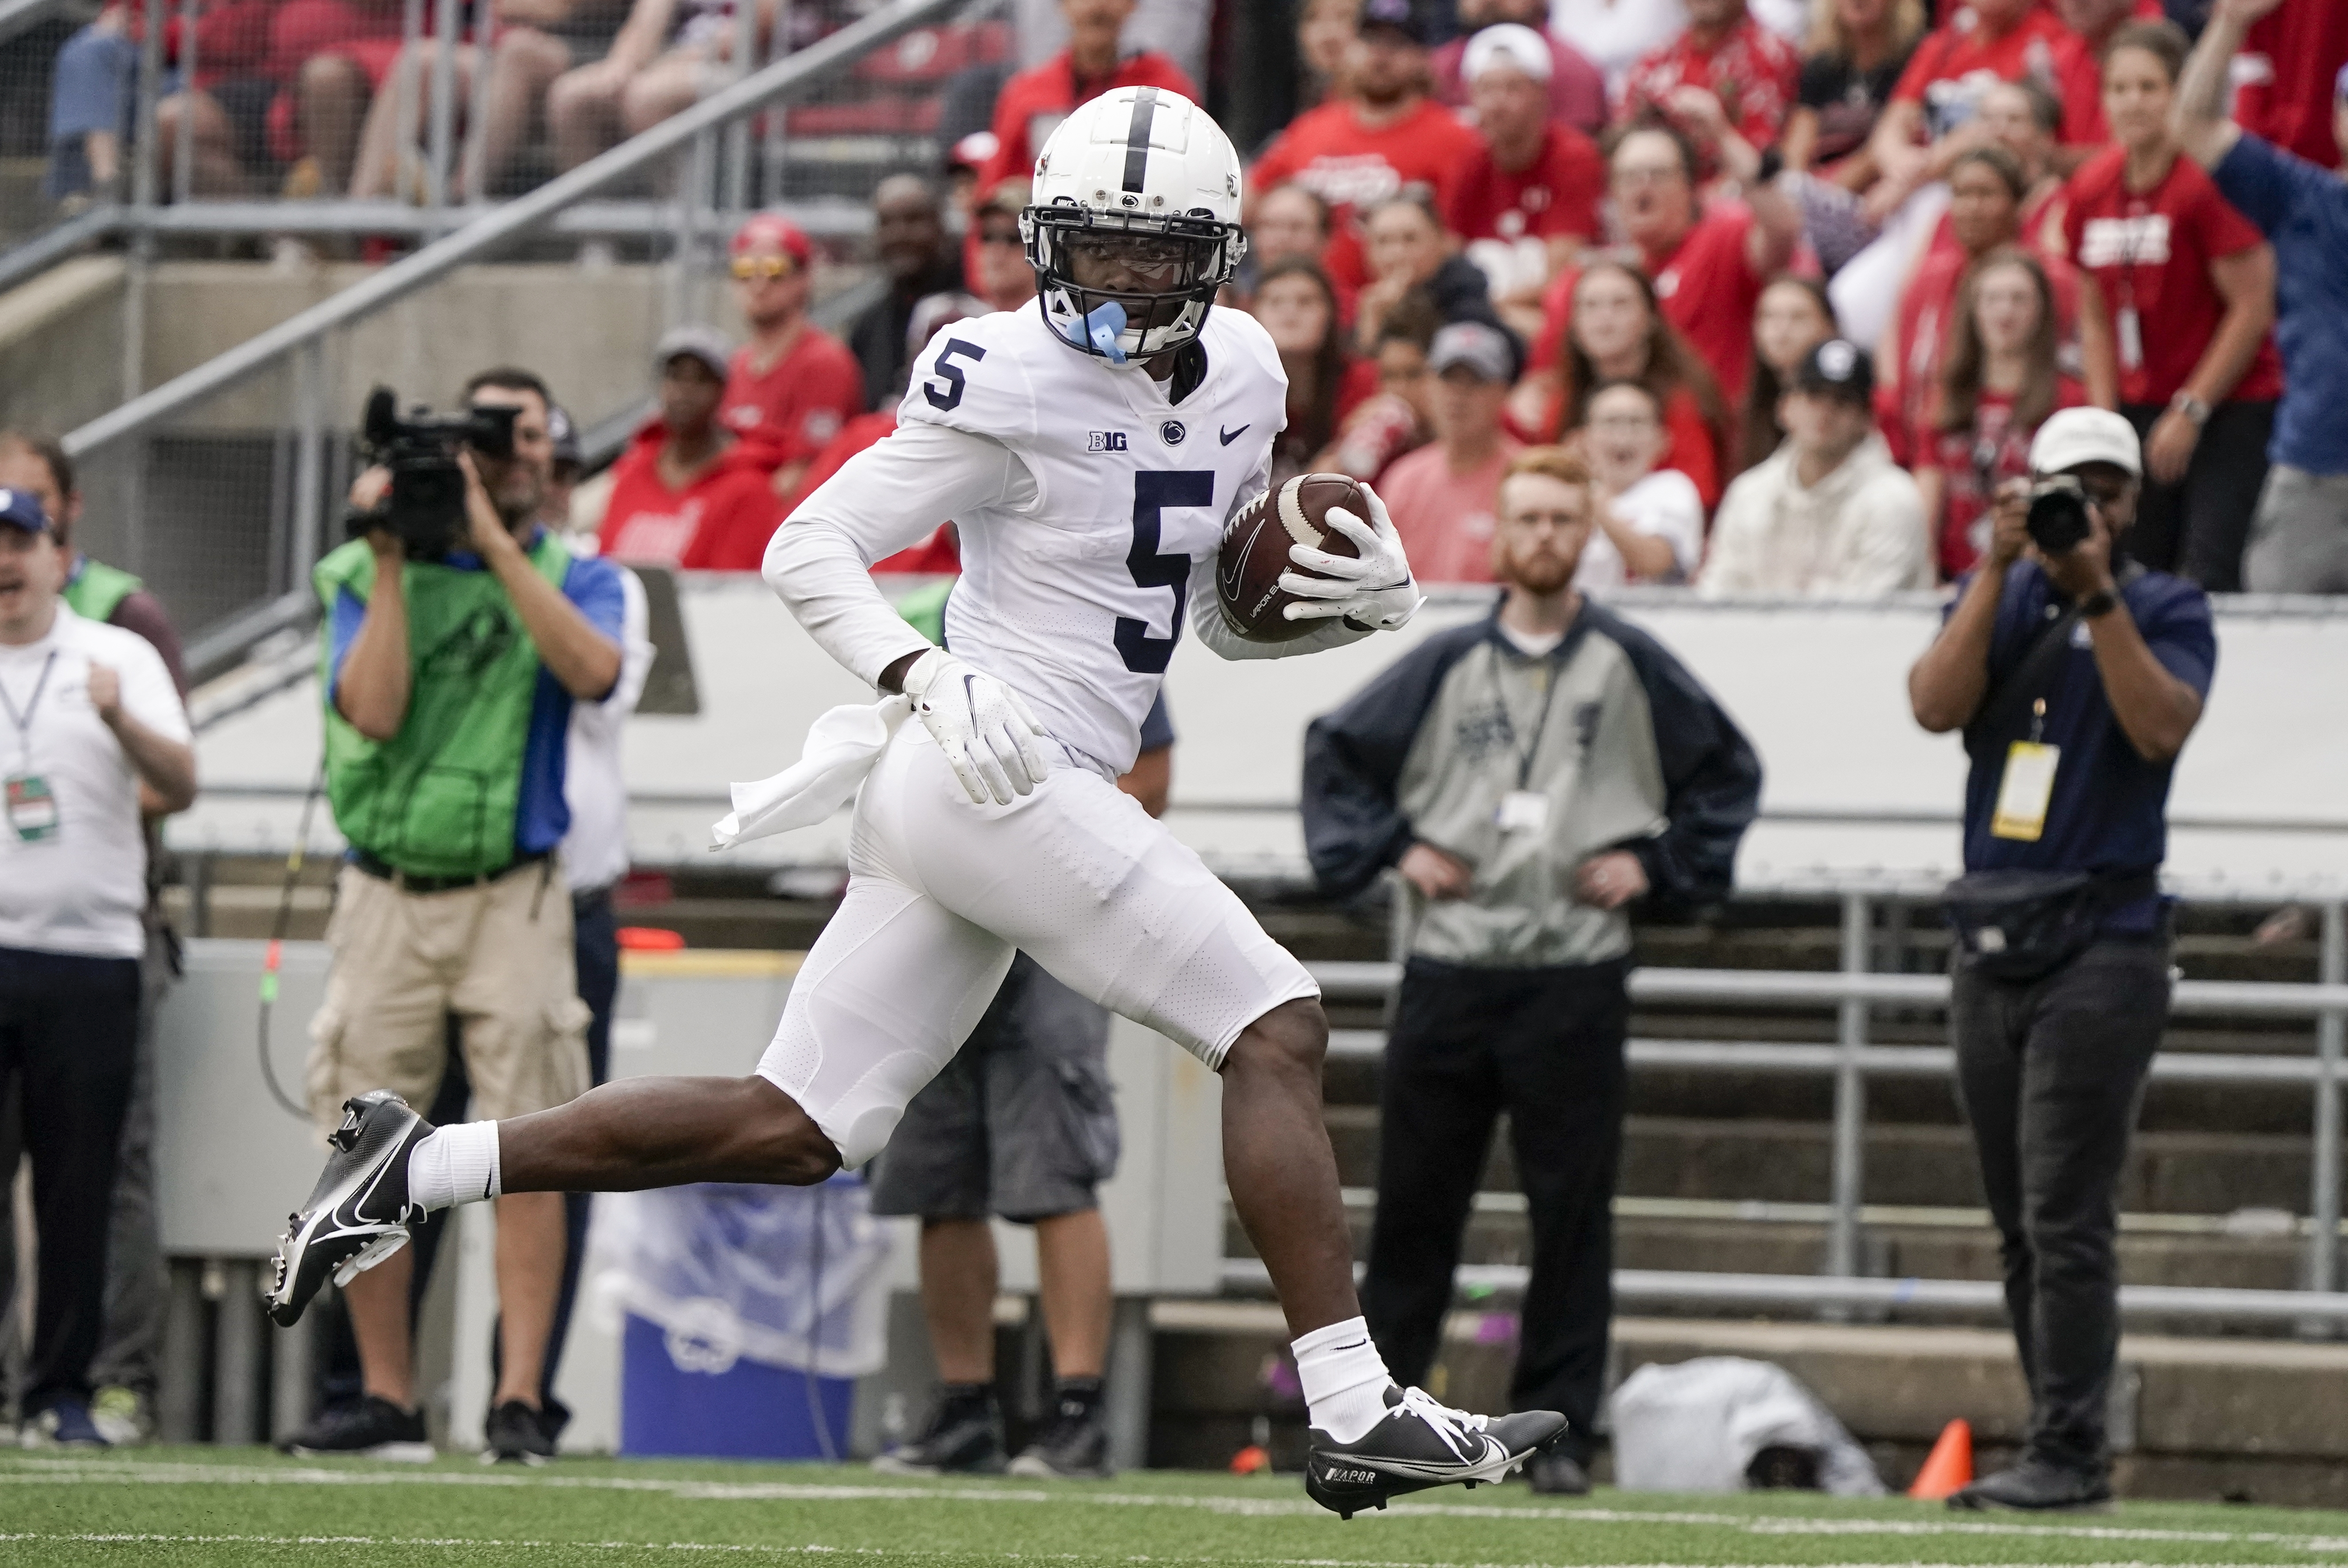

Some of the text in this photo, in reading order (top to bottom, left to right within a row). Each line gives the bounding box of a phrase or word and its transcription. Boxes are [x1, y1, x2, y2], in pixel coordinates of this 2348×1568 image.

[924, 337, 987, 412] 5
[1113, 470, 1215, 674] 5
[1249, 593, 1272, 618] VAPOR
